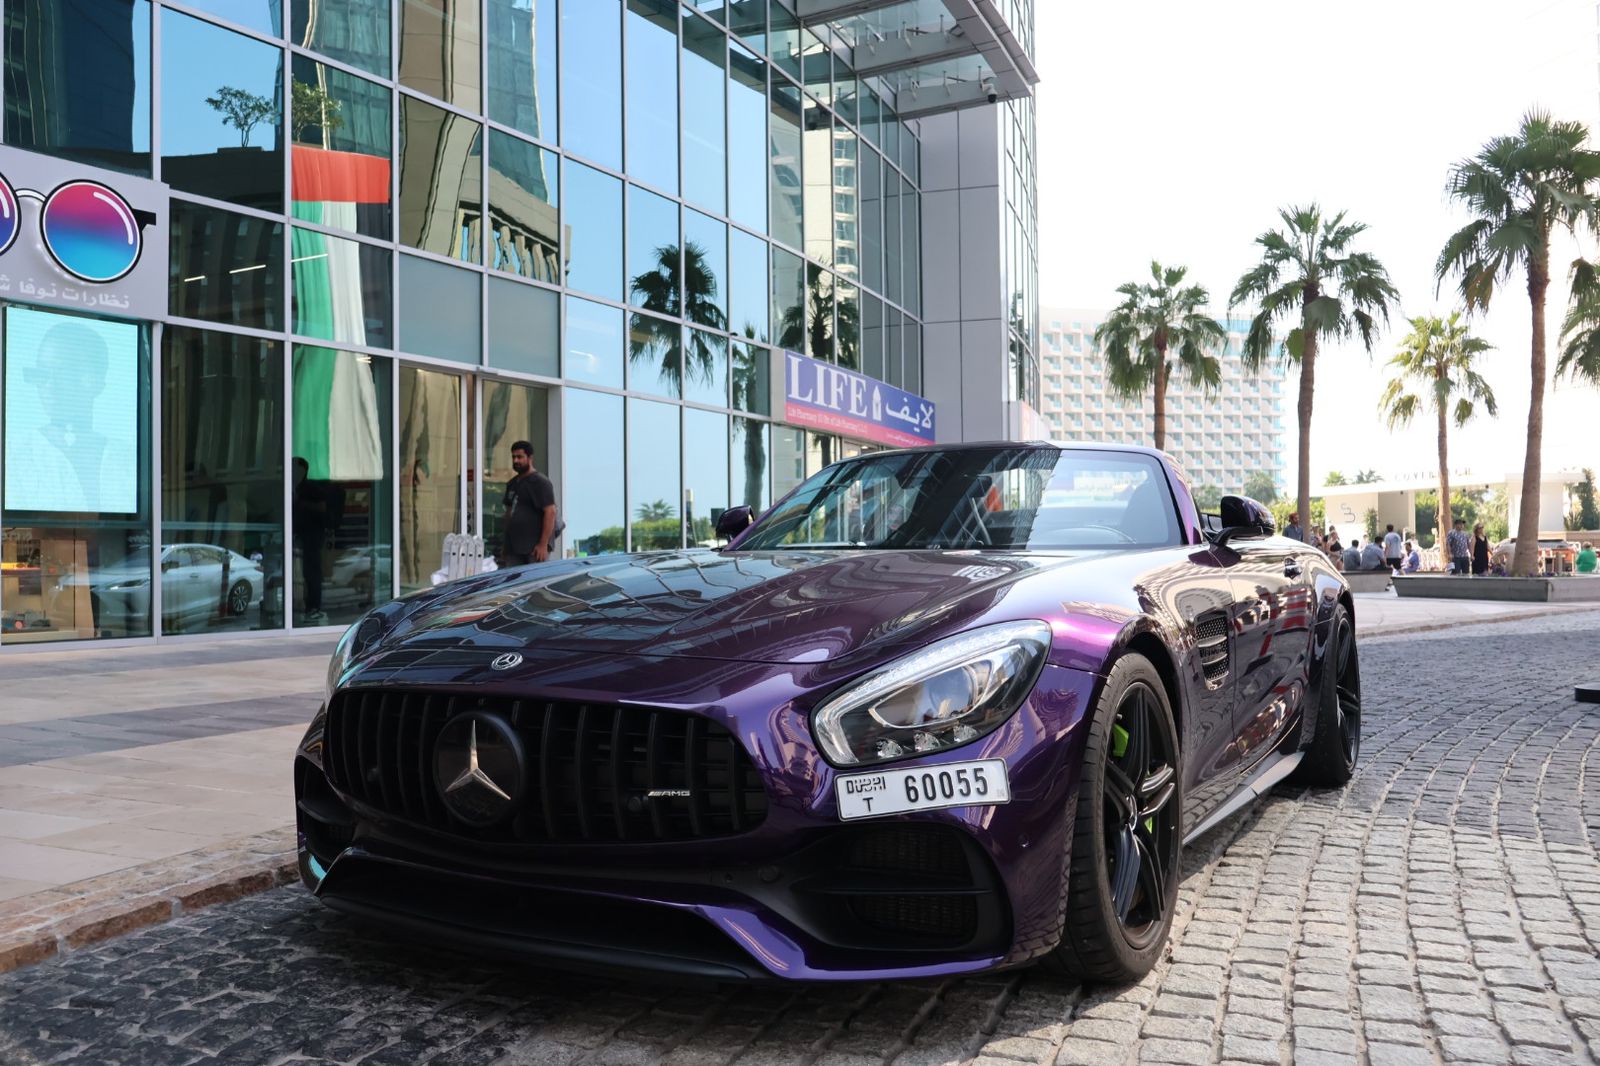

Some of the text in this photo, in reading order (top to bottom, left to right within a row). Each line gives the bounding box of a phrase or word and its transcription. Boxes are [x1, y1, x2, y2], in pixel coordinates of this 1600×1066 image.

[62, 287, 130, 309] نظارات
[788, 354, 868, 418] LIFE
[885, 397, 934, 432] لايف
[904, 767, 989, 803] 60055
[862, 797, 874, 812] T
